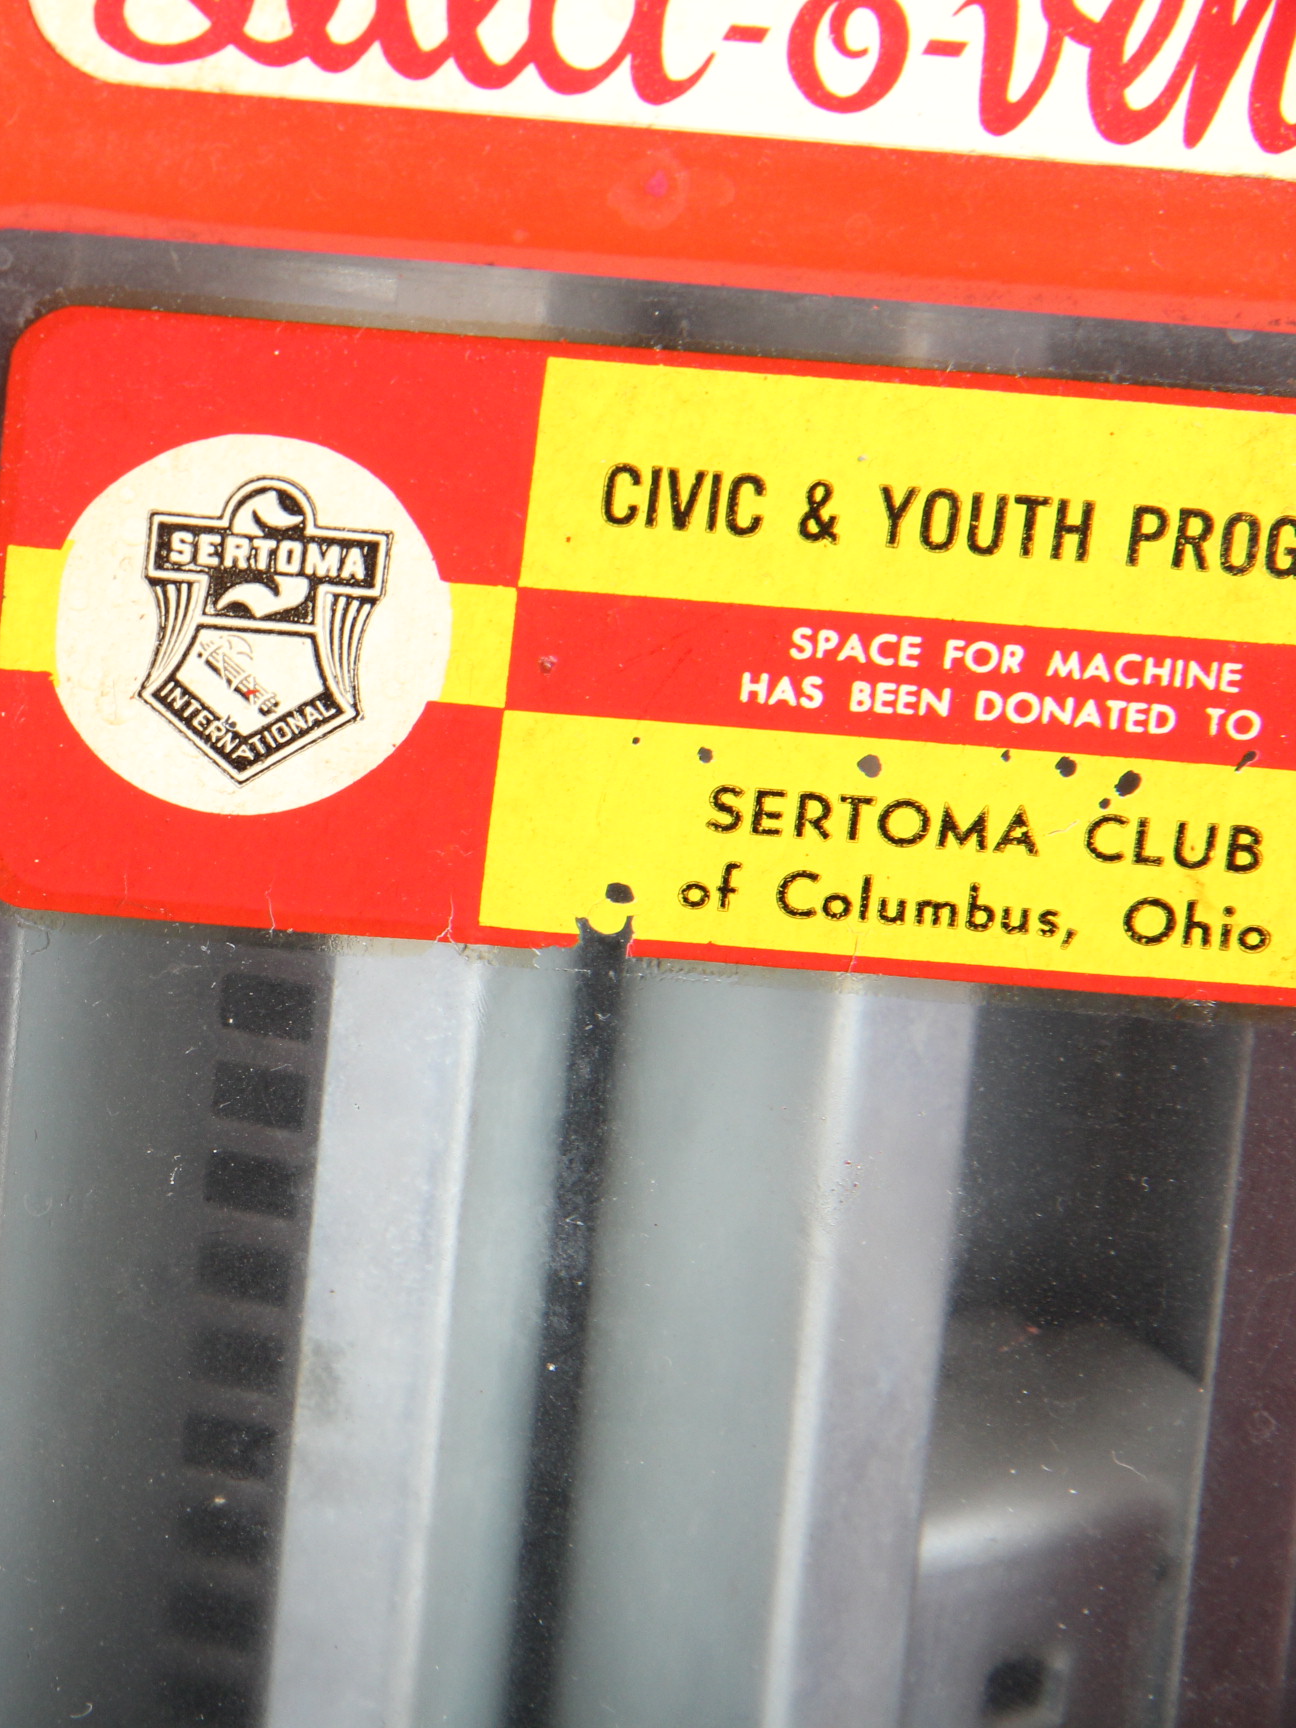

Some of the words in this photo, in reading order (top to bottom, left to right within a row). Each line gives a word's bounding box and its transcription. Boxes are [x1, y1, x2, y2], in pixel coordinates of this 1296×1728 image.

[168, 530, 367, 582] SERTOMA
[602, 461, 768, 539] CIVIC
[797, 479, 841, 547] &
[878, 482, 1098, 564] YOUTH
[1125, 503, 1296, 580] PROG
[790, 627, 923, 669] SPACE
[943, 638, 1025, 676] FOR
[1045, 648, 1244, 695] MACHINE
[159, 680, 338, 762] INTERNATIONAL
[739, 671, 825, 709] HAS
[849, 681, 952, 719] BEEN
[974, 690, 1177, 736] DONATED
[1206, 705, 1263, 742] TO
[704, 783, 1041, 858] SERTOMA
[1082, 814, 1265, 877] CLUB
[677, 860, 745, 913] of
[775, 869, 1080, 951] Columbus,
[1122, 896, 1273, 955] Ohio
